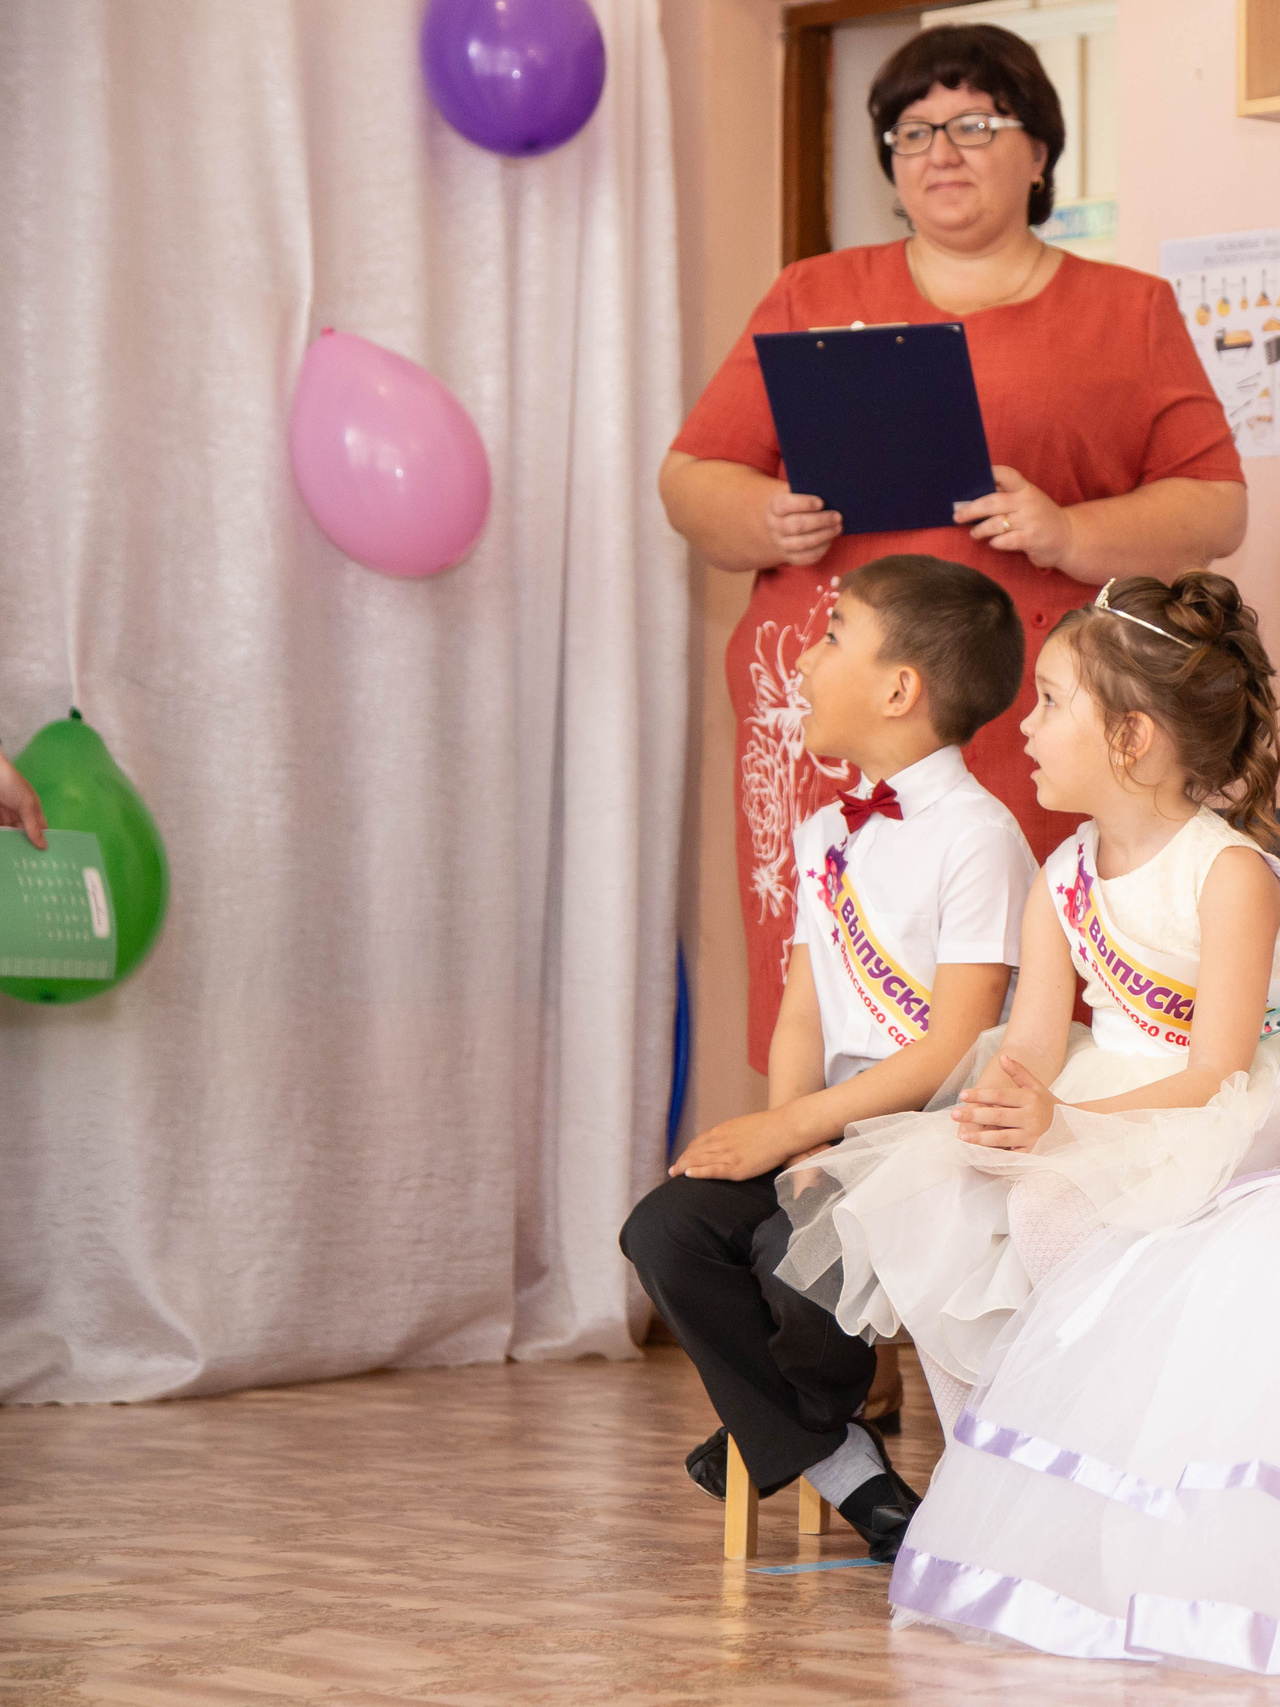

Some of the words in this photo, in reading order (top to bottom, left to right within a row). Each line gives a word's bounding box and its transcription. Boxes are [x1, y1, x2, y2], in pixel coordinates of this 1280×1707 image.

[840, 940, 887, 1024] детского
[1091, 960, 1160, 1037] детского
[1165, 1031, 1190, 1046] са
